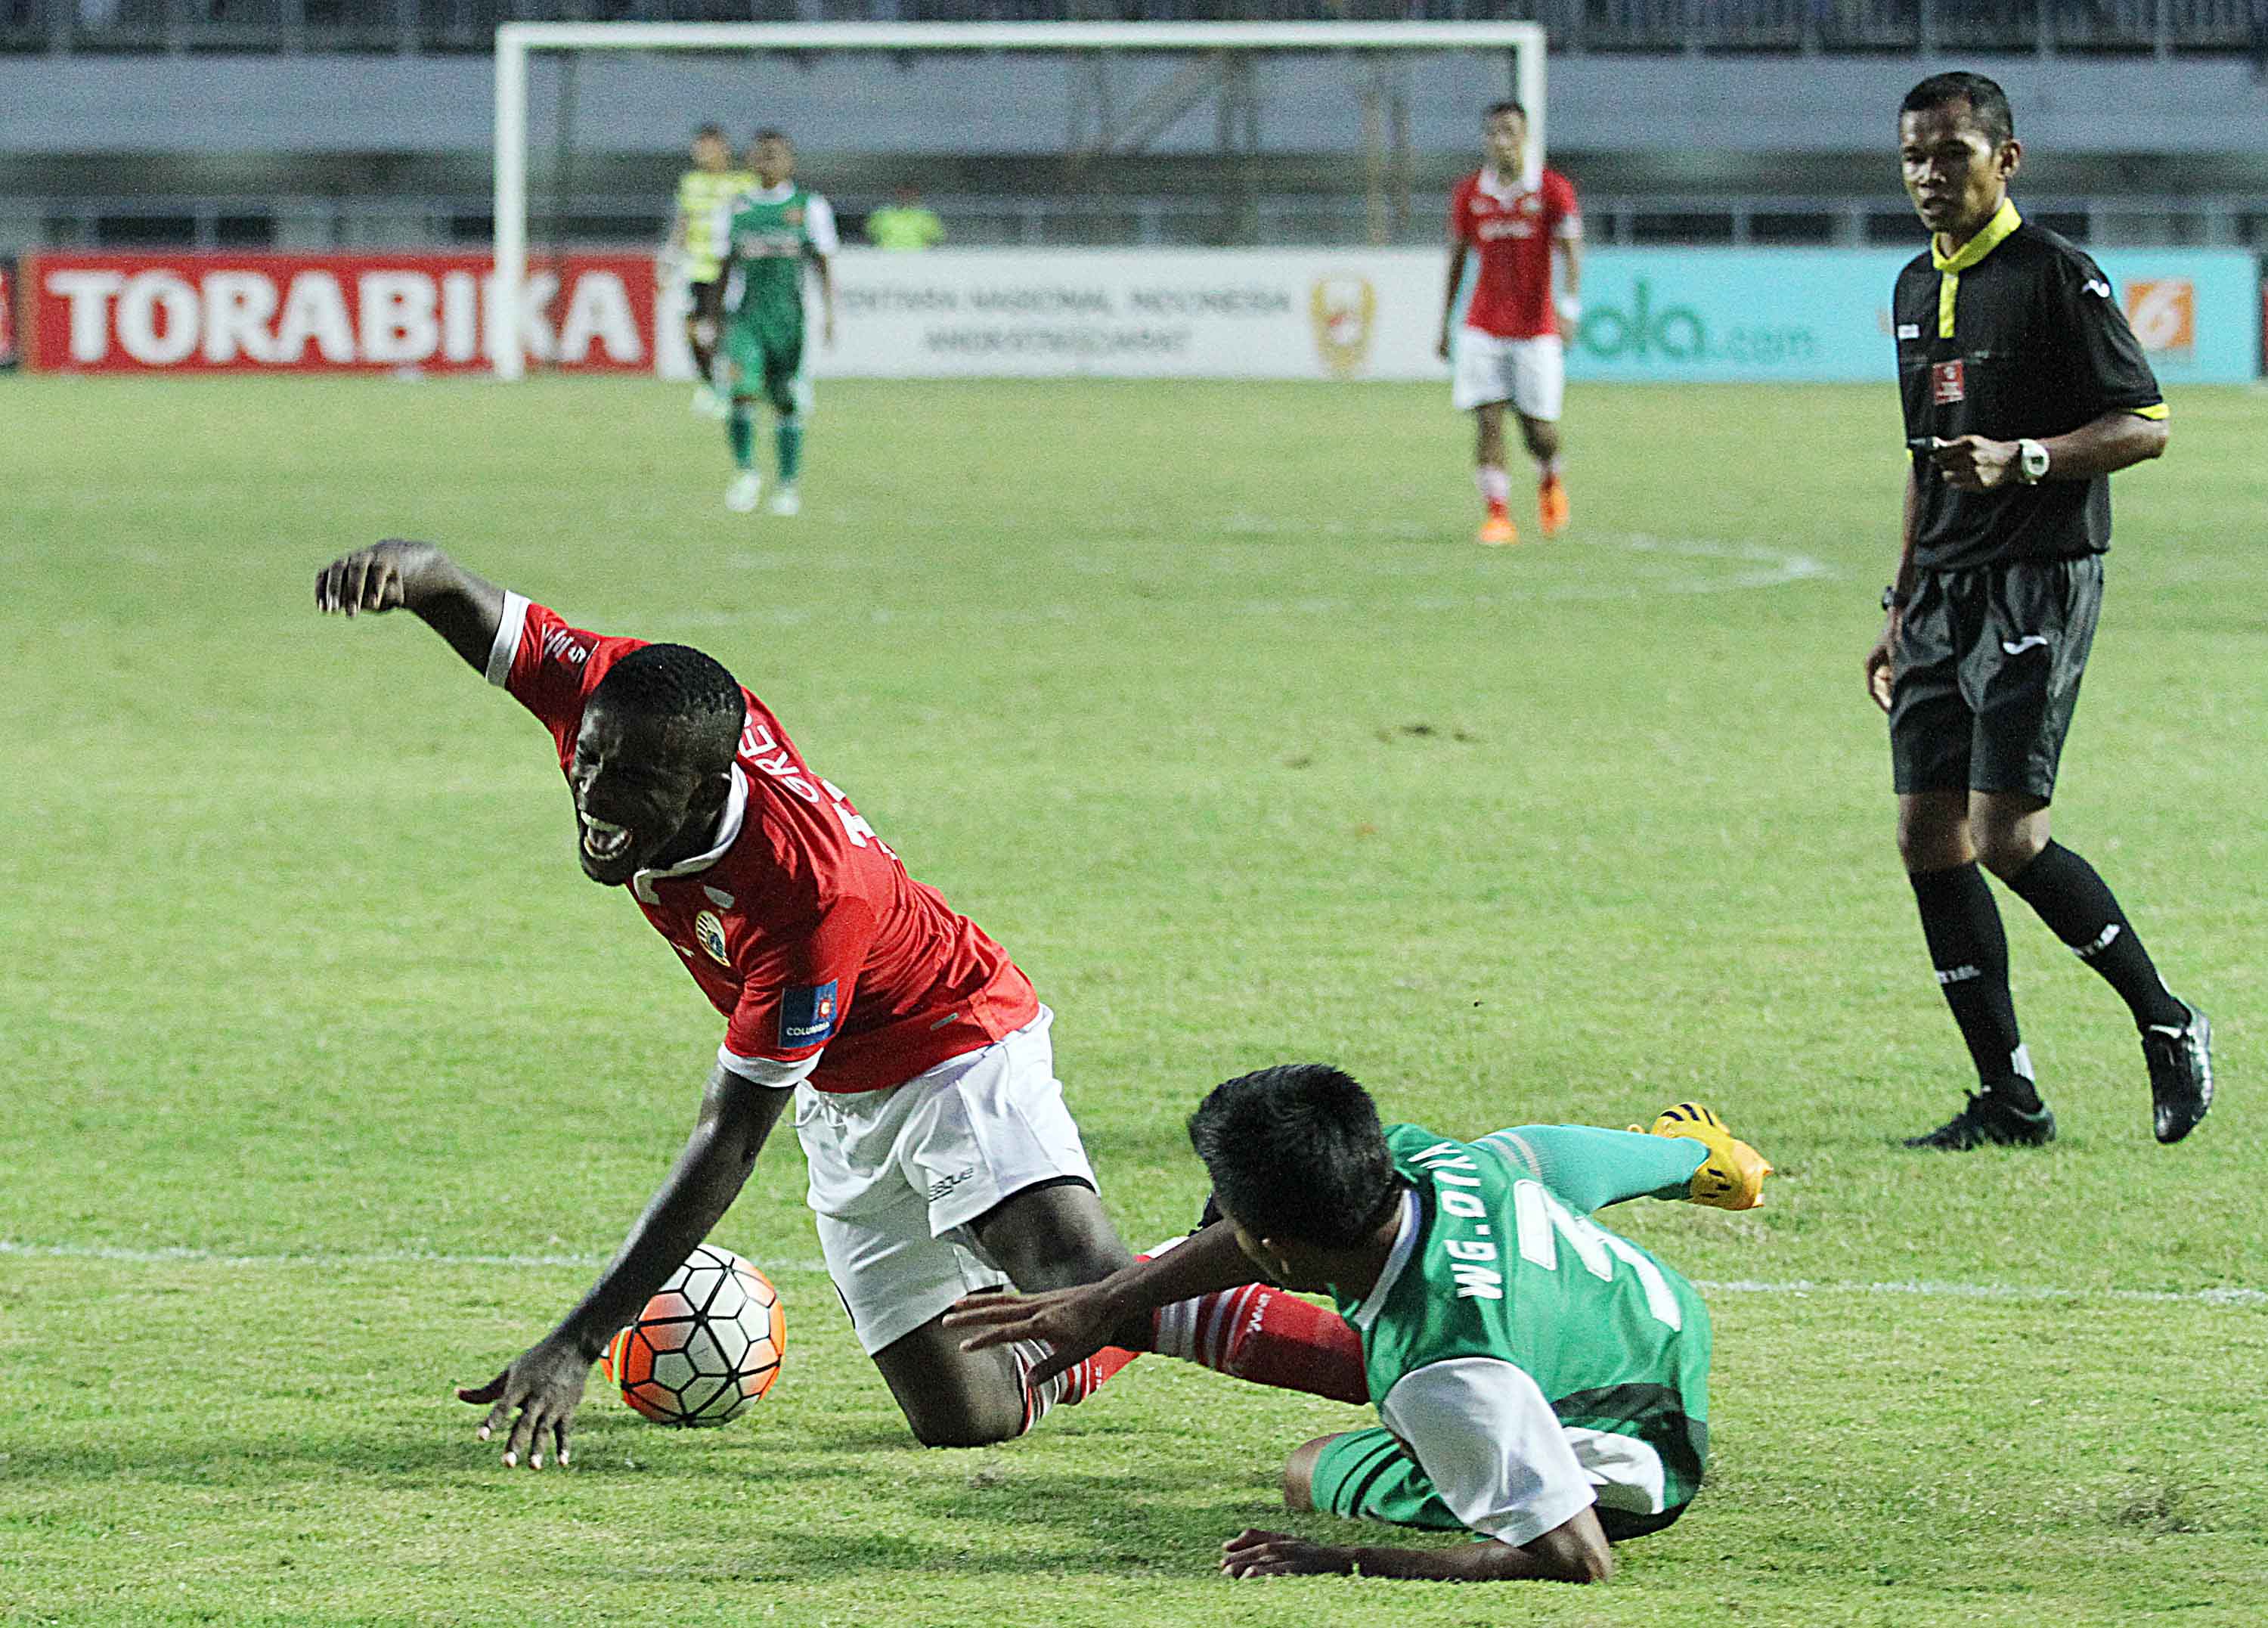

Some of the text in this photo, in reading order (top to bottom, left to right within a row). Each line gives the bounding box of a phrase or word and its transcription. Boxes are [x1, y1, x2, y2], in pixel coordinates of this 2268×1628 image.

[47, 268, 642, 364] TORABIKA
[1577, 278, 1817, 361] ola.com
[738, 713, 820, 804] GRE
